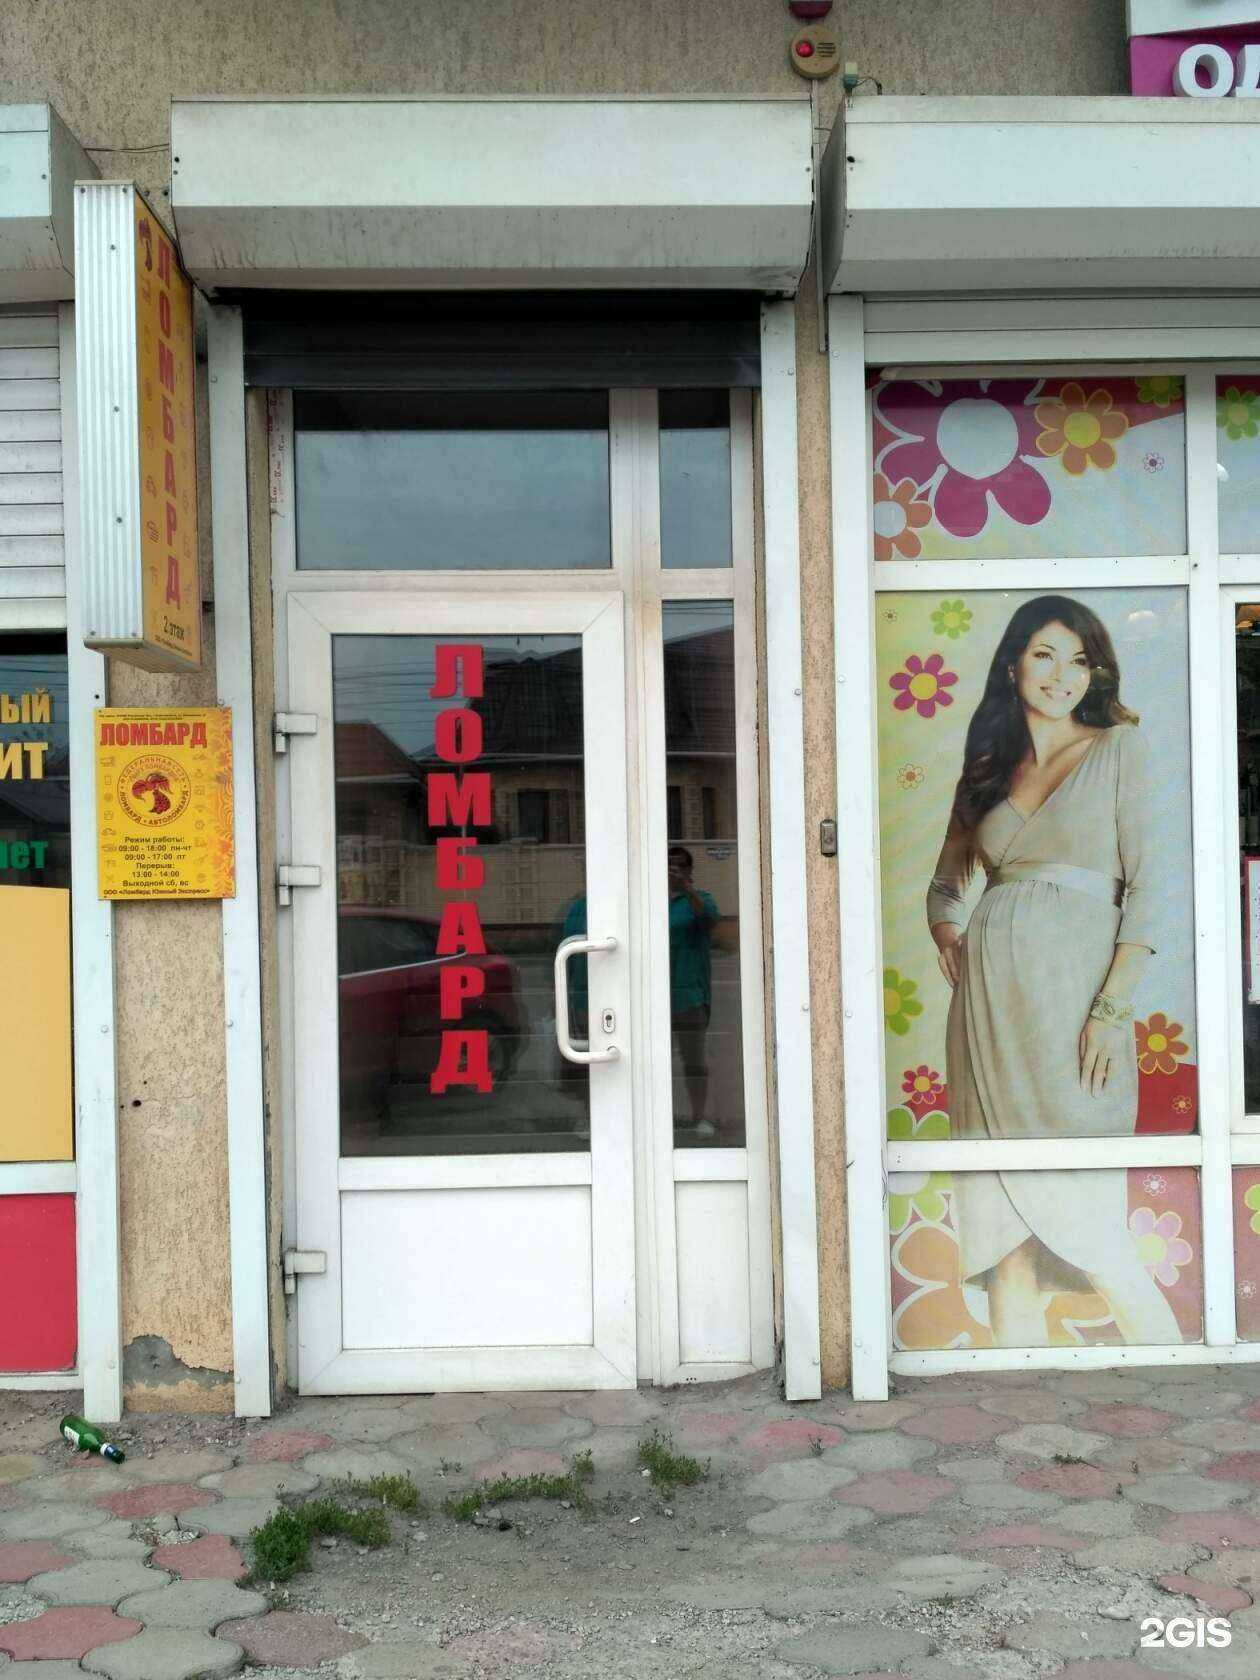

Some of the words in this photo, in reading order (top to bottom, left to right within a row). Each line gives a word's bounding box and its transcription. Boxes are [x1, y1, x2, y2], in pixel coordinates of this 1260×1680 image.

[158, 234, 181, 610] ЛОМБАРД
[163, 615, 168, 633] 2
[99, 722, 208, 748] ЛОМБАРД
[152, 836, 185, 844] работы:
[136, 862, 176, 870] Перерыв:
[427, 644, 493, 1094] ЛОМБАРД
